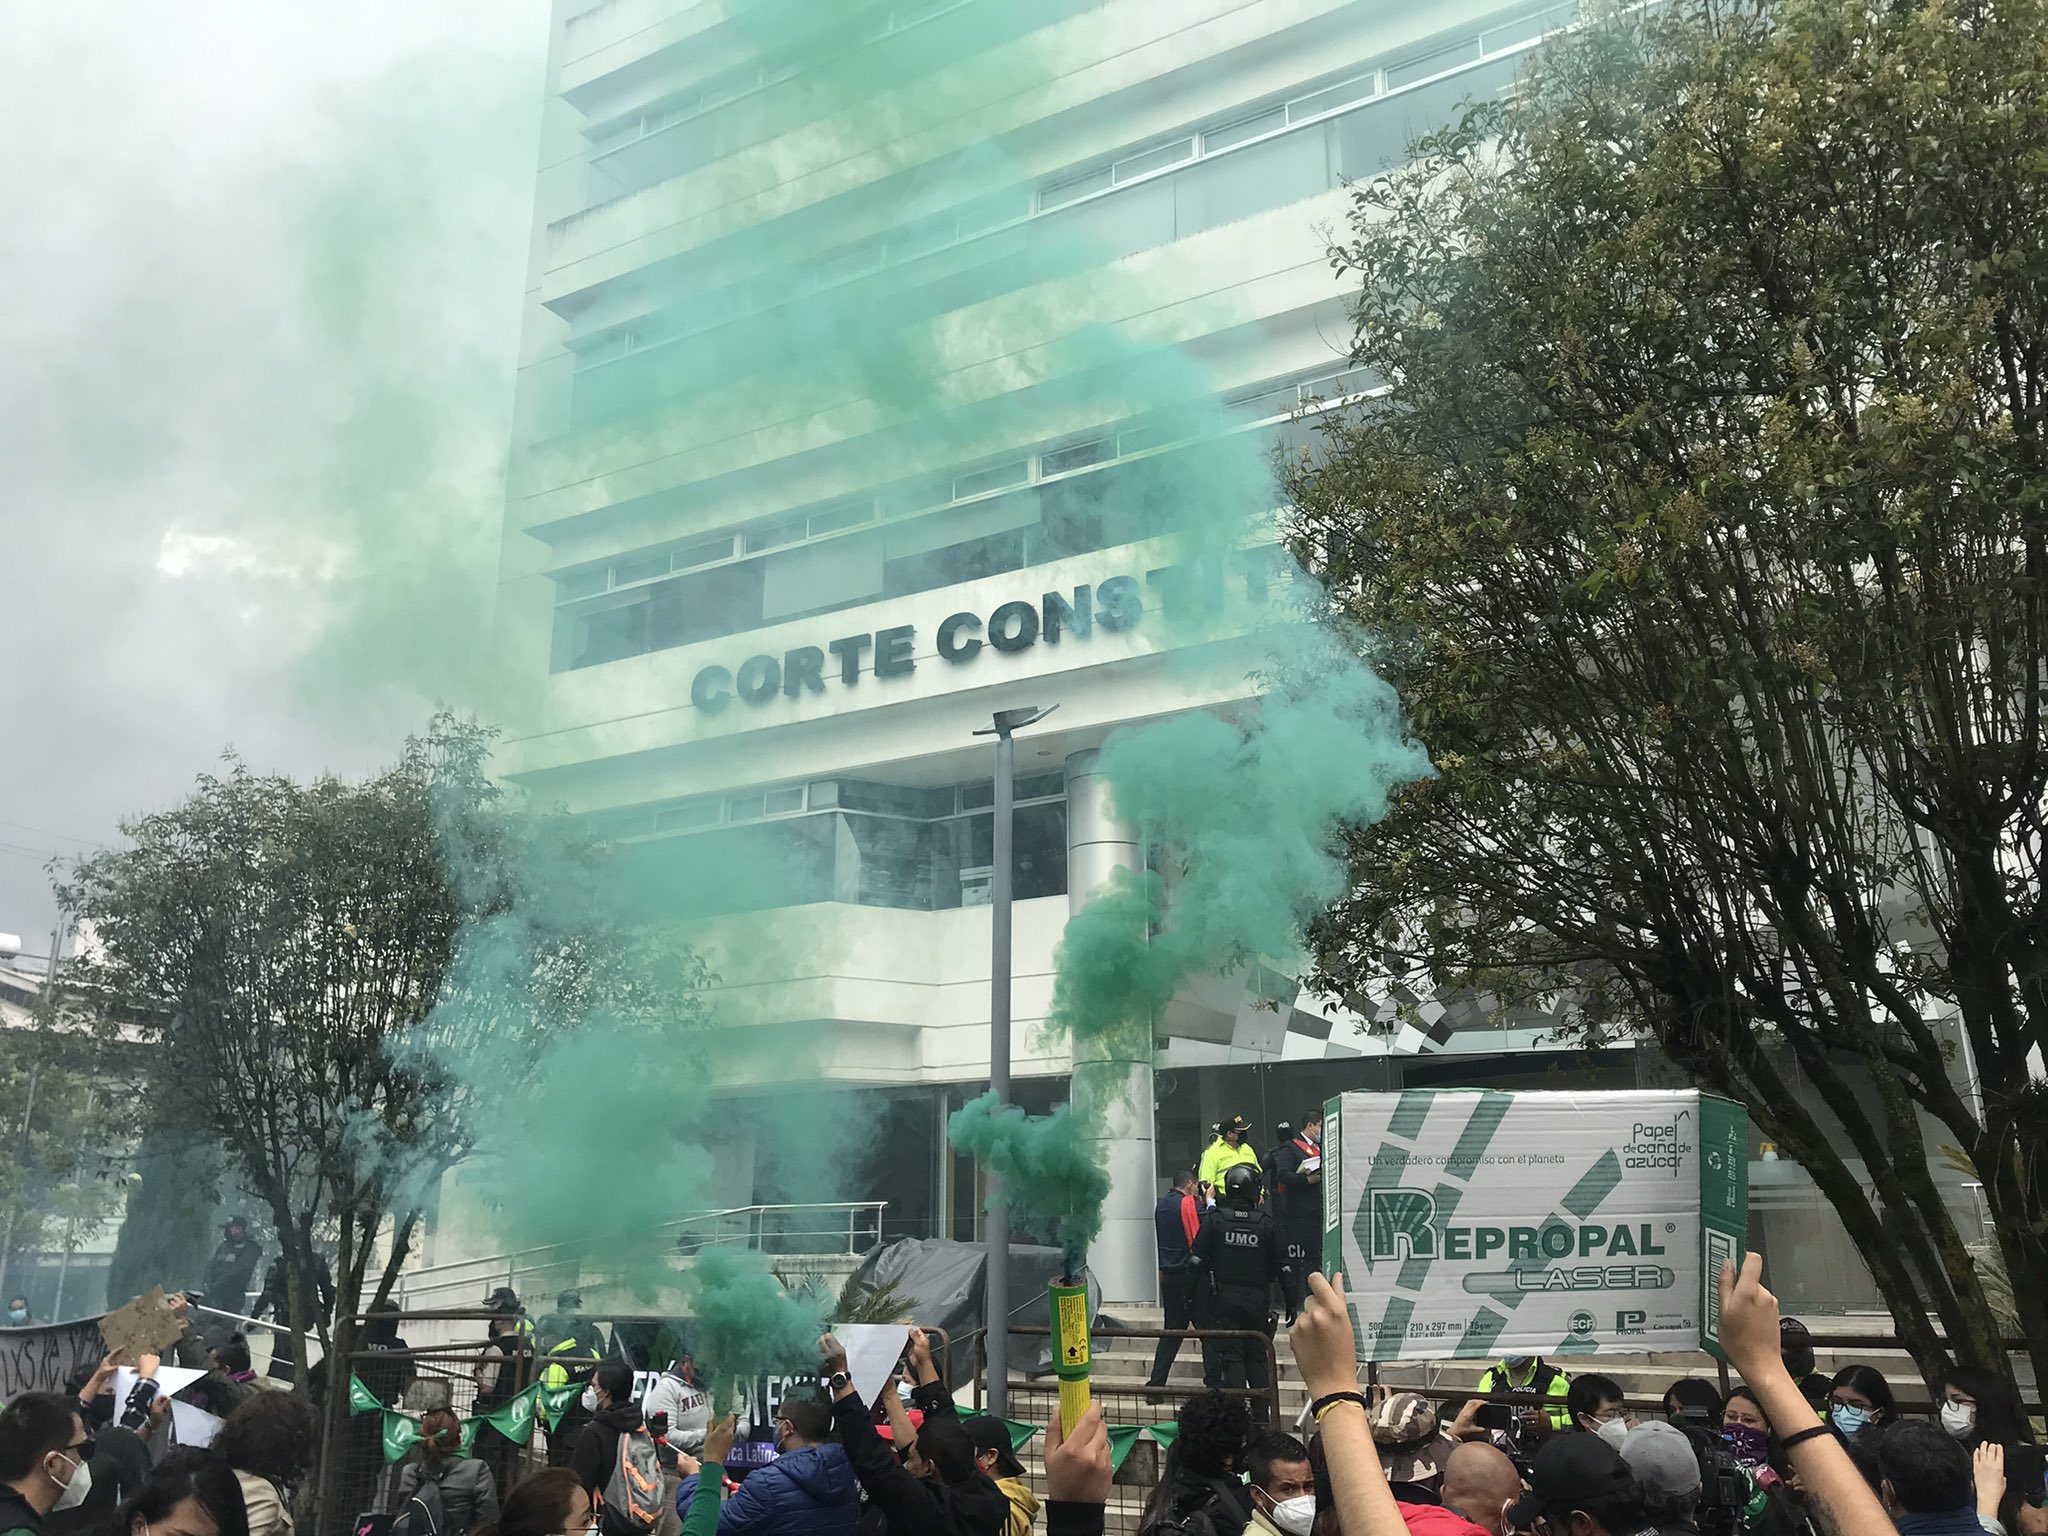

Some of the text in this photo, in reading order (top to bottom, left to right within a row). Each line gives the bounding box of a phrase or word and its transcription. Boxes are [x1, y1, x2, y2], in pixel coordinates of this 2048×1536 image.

[691, 624, 915, 714] CORTE
[1633, 1121, 1677, 1143] Papel
[1623, 1139, 1691, 1154] de caña de
[1368, 1154, 1565, 1167] Un verdadero compromiso con el planeta
[1625, 1155, 1682, 1168] azúcar
[1369, 1187, 1666, 1261] REPROPAL
[1225, 1232, 1259, 1245] UMO
[1515, 1264, 1664, 1291] LASER
[1368, 1322, 1383, 1331] 500
[1411, 1323, 1424, 1332] 210
[1431, 1322, 1447, 1331] 297
[1448, 1323, 1462, 1331] mm
[1573, 1319, 1593, 1330] ECF
